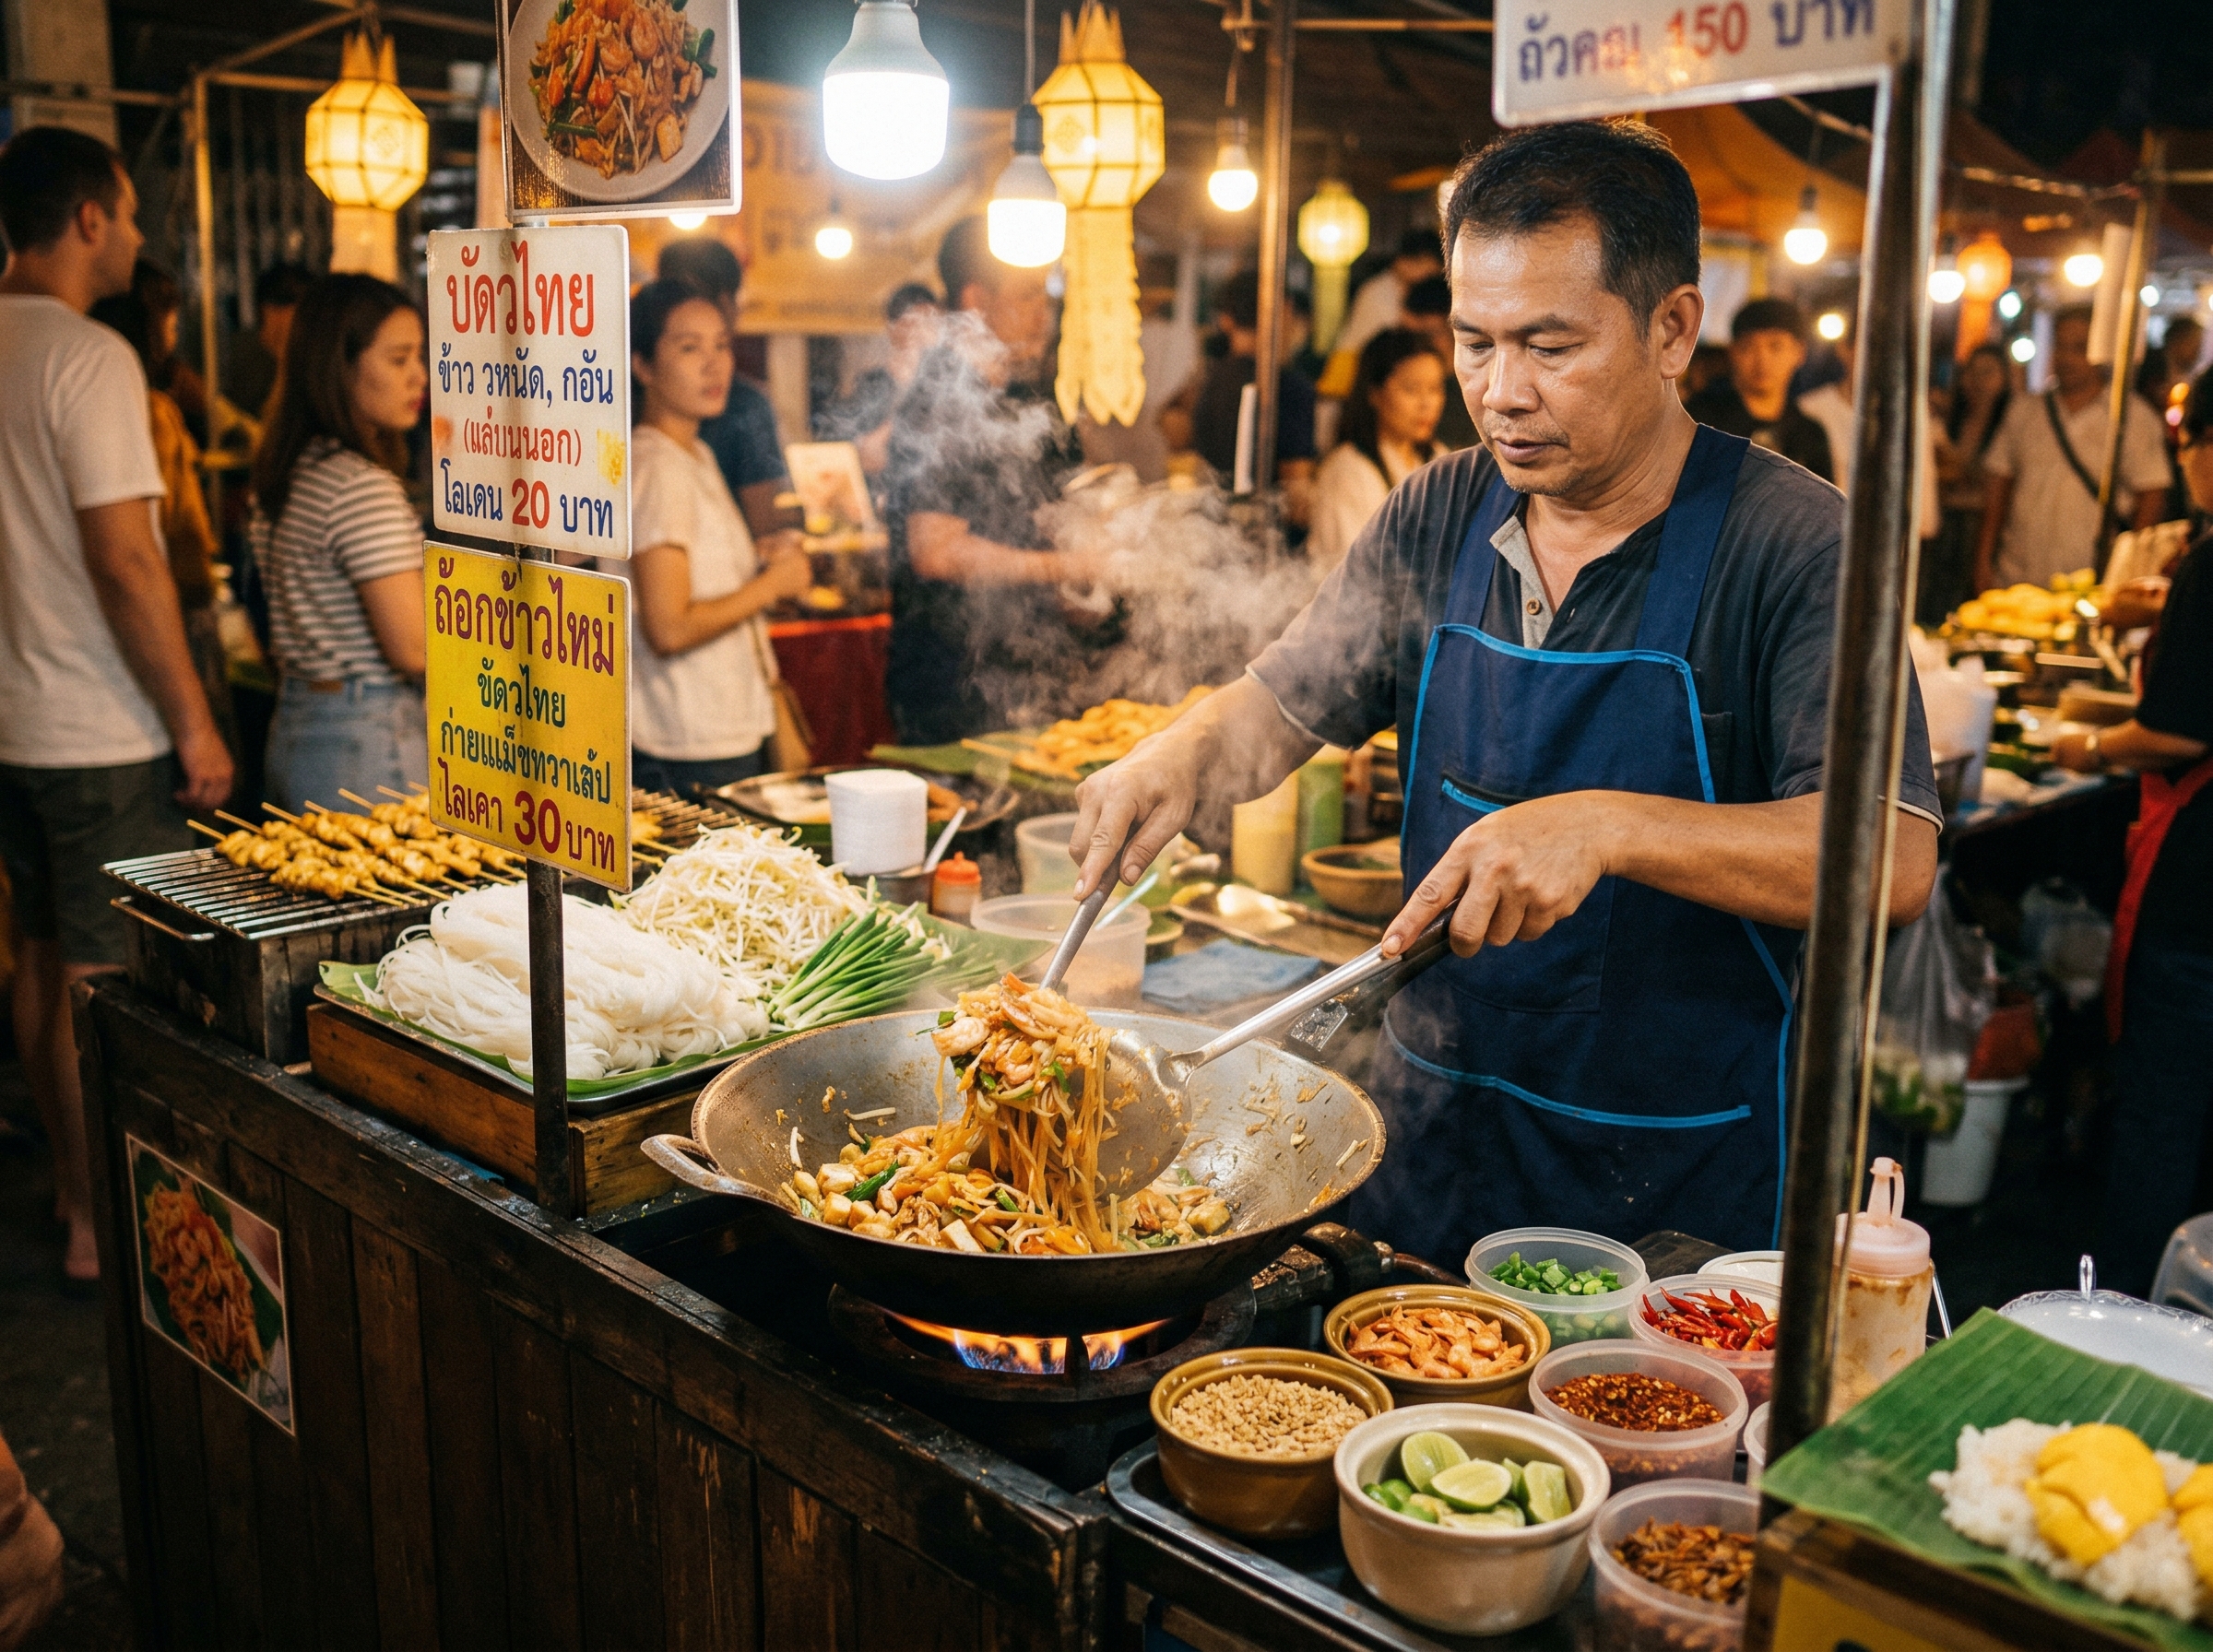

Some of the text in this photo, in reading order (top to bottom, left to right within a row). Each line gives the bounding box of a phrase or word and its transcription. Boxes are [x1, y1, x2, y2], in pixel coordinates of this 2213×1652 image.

[1665, 3, 1747, 57] 150
[446, 240, 595, 337] บัดวไทย
[438, 341, 474, 395] ข้าว
[511, 478, 550, 529] 20
[560, 493, 613, 538] บาท
[514, 790, 562, 854] 30
[565, 820, 615, 873] บาท
